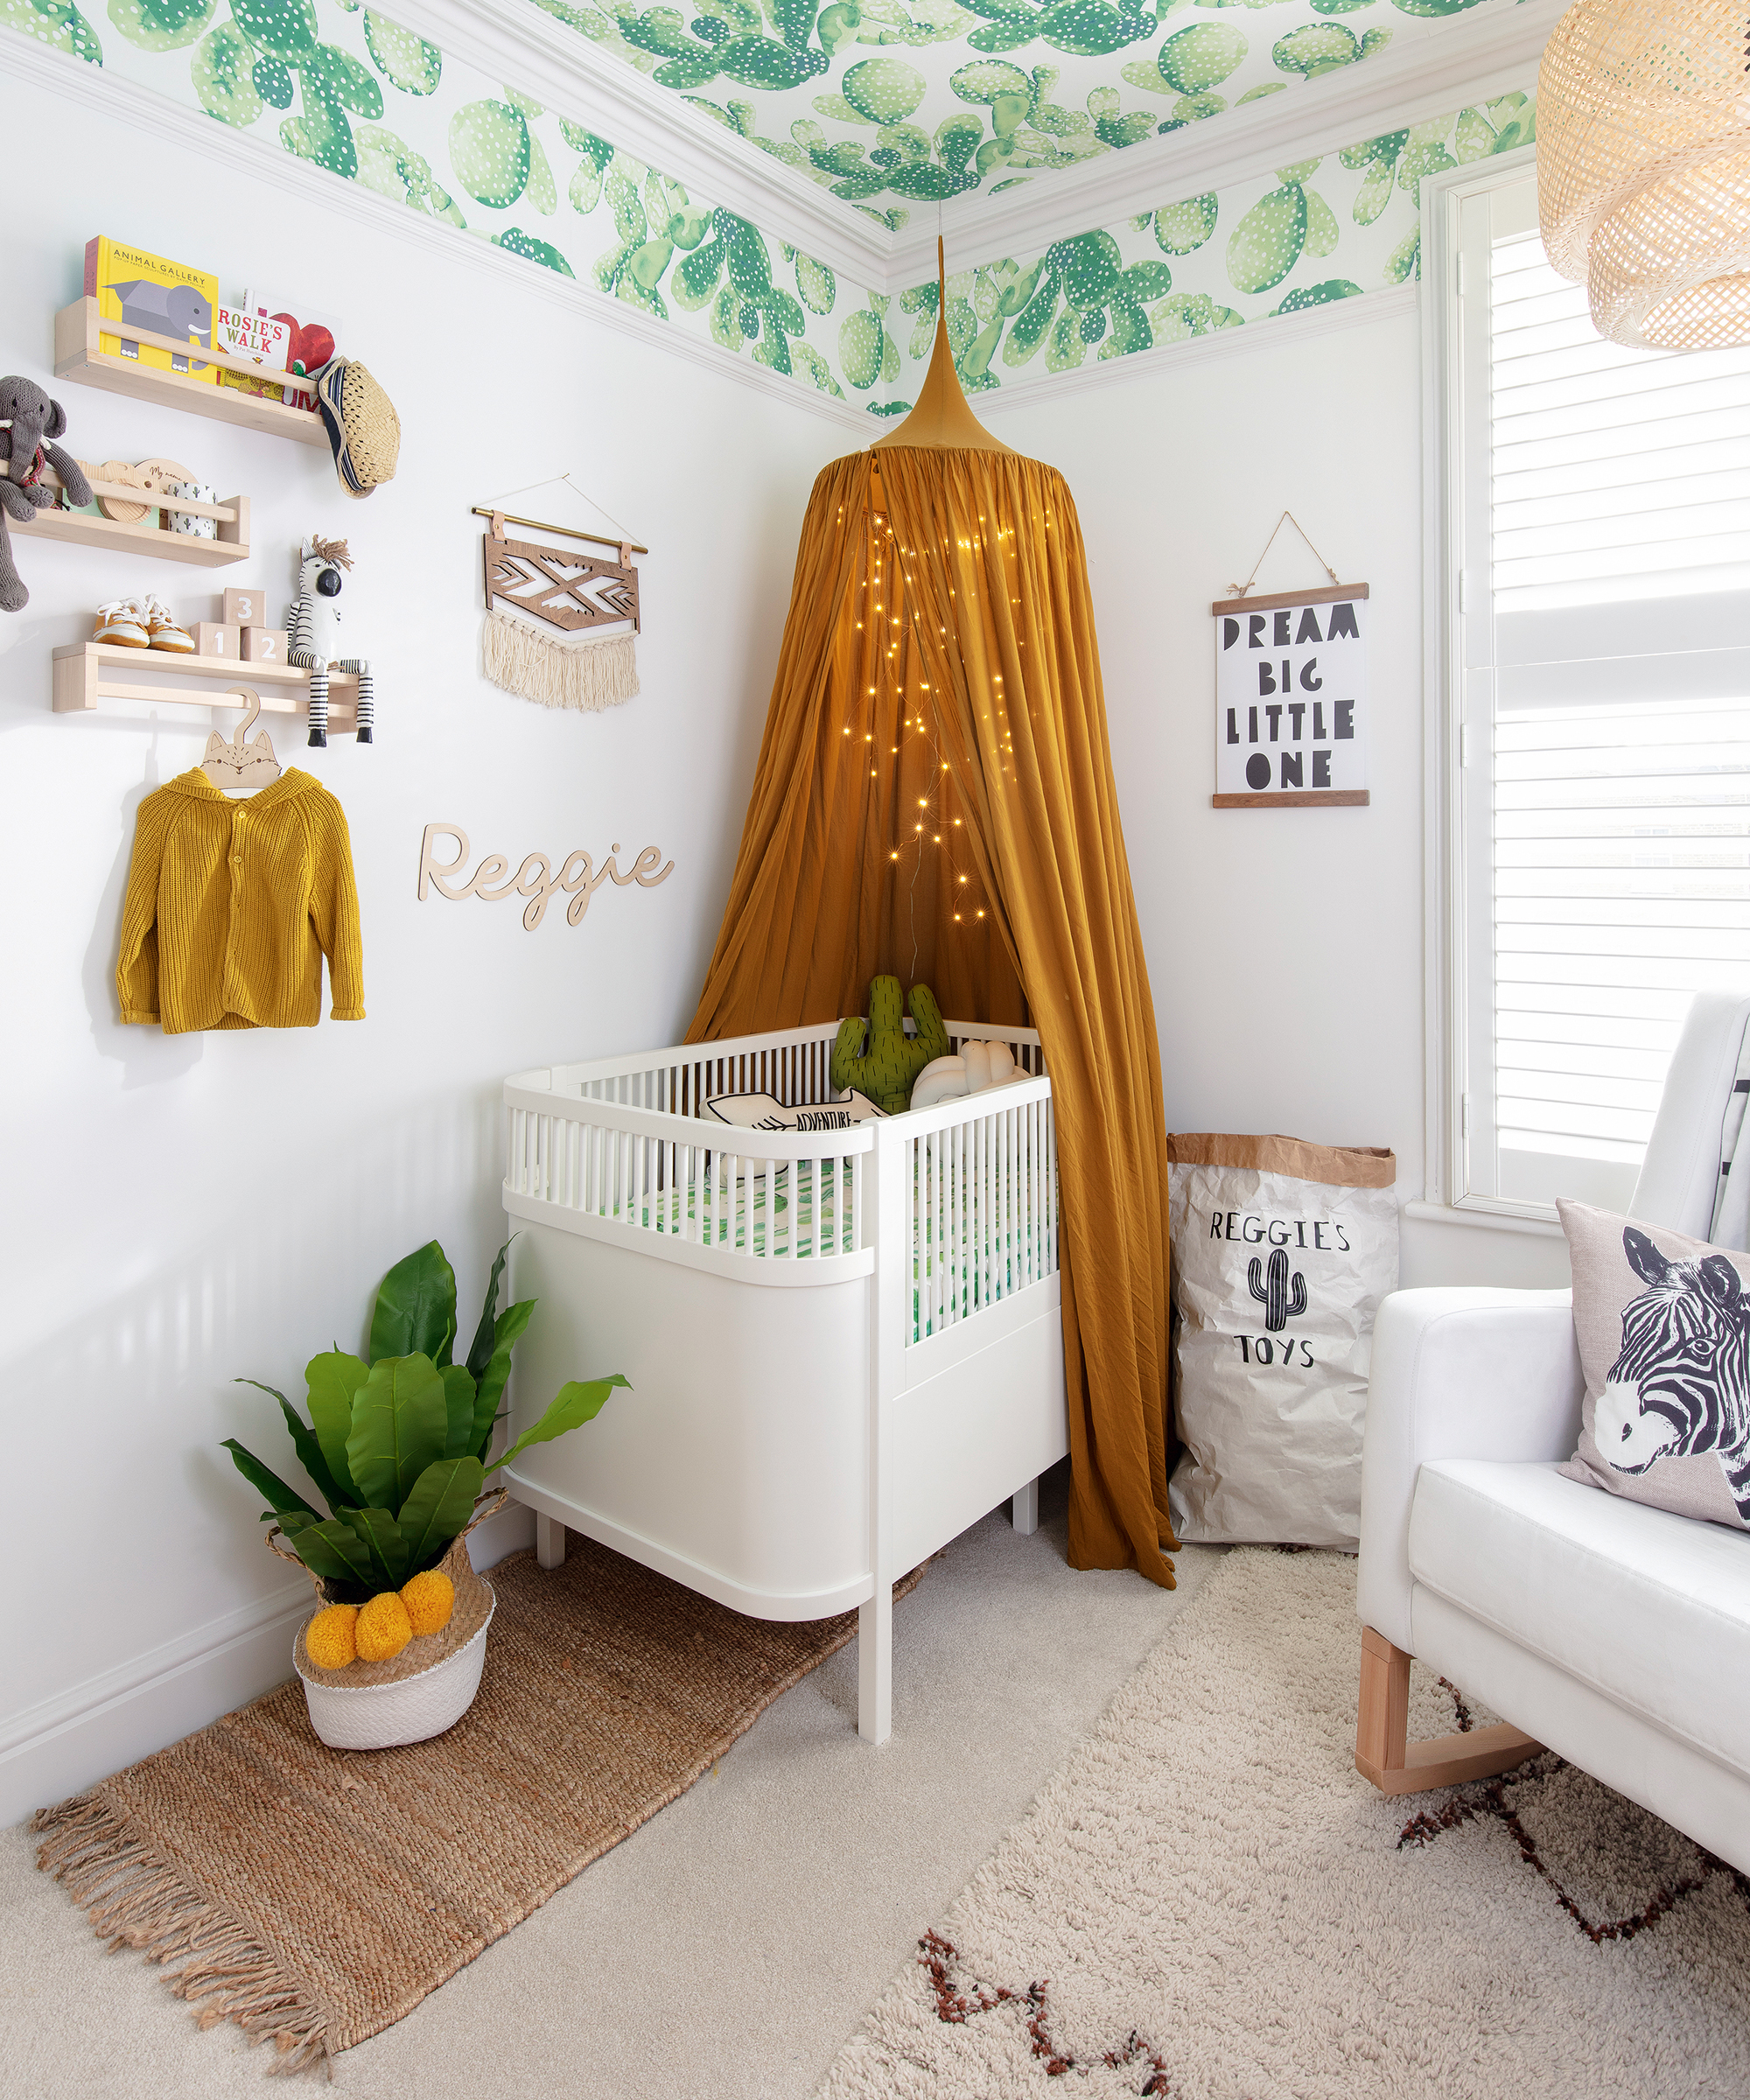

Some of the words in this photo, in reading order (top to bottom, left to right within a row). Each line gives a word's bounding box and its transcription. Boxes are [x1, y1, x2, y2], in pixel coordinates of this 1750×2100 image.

[113, 249, 157, 269] ANIMAL
[159, 264, 206, 285] GALLERY
[218, 308, 283, 340] ROSIE'S
[227, 327, 272, 354] WALK
[150, 466, 164, 480] My
[237, 597, 253, 620] 3
[214, 632, 224, 654] 1
[1223, 603, 1361, 651] DREAM
[261, 636, 276, 659] 2
[1258, 657, 1323, 696] BIG
[1227, 699, 1355, 745] LITTLE
[1245, 750, 1333, 790] ONE
[417, 822, 675, 932] Reggie
[796, 1110, 851, 1132] ADVENTURE
[1233, 1334, 1314, 1368] TOYS
